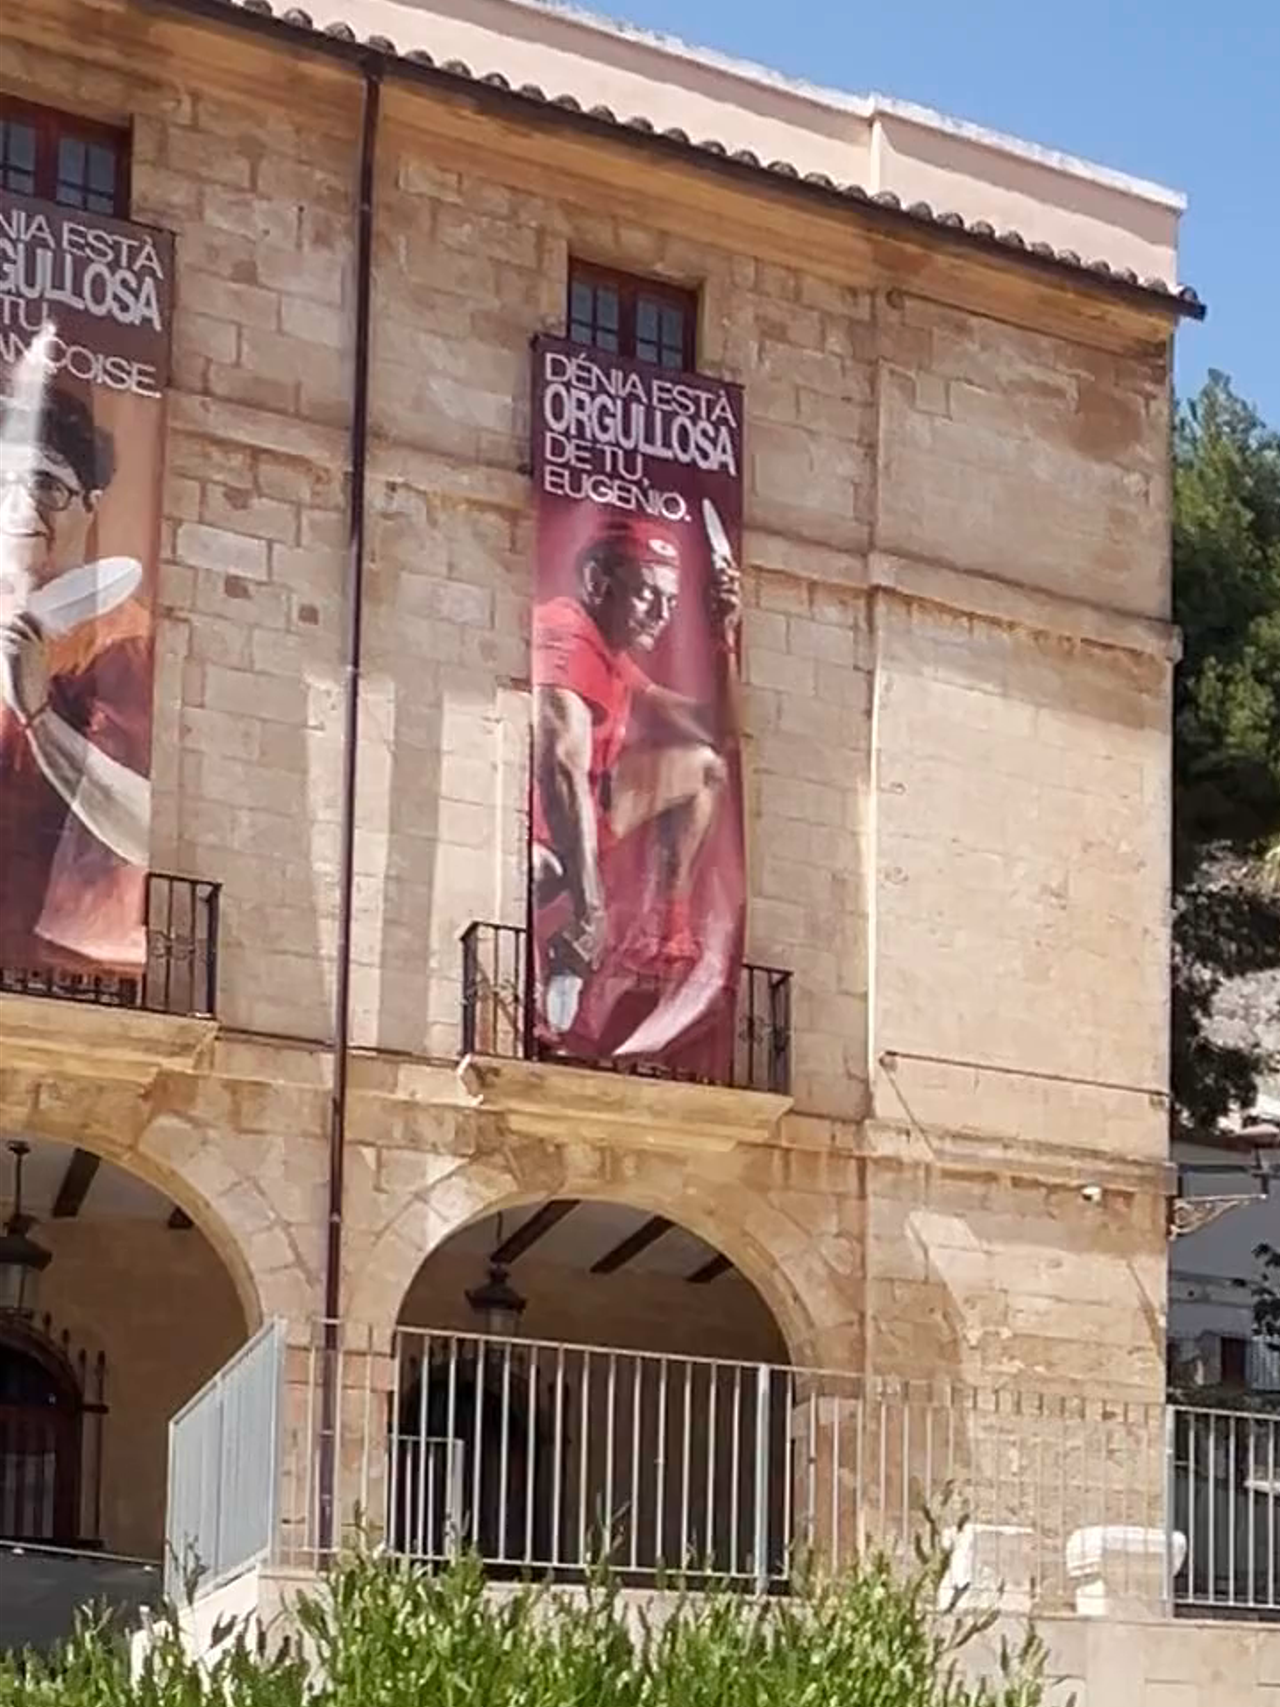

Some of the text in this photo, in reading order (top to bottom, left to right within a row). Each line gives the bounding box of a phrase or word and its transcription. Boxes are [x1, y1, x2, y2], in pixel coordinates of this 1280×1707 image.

[62, 220, 164, 280] ESTÀ
[545, 351, 737, 428] DÉNIA ESTÀ
[543, 382, 737, 477] ORGULLOSA
[545, 431, 650, 487] DE TU,
[544, 465, 692, 521] EUGENIO.
